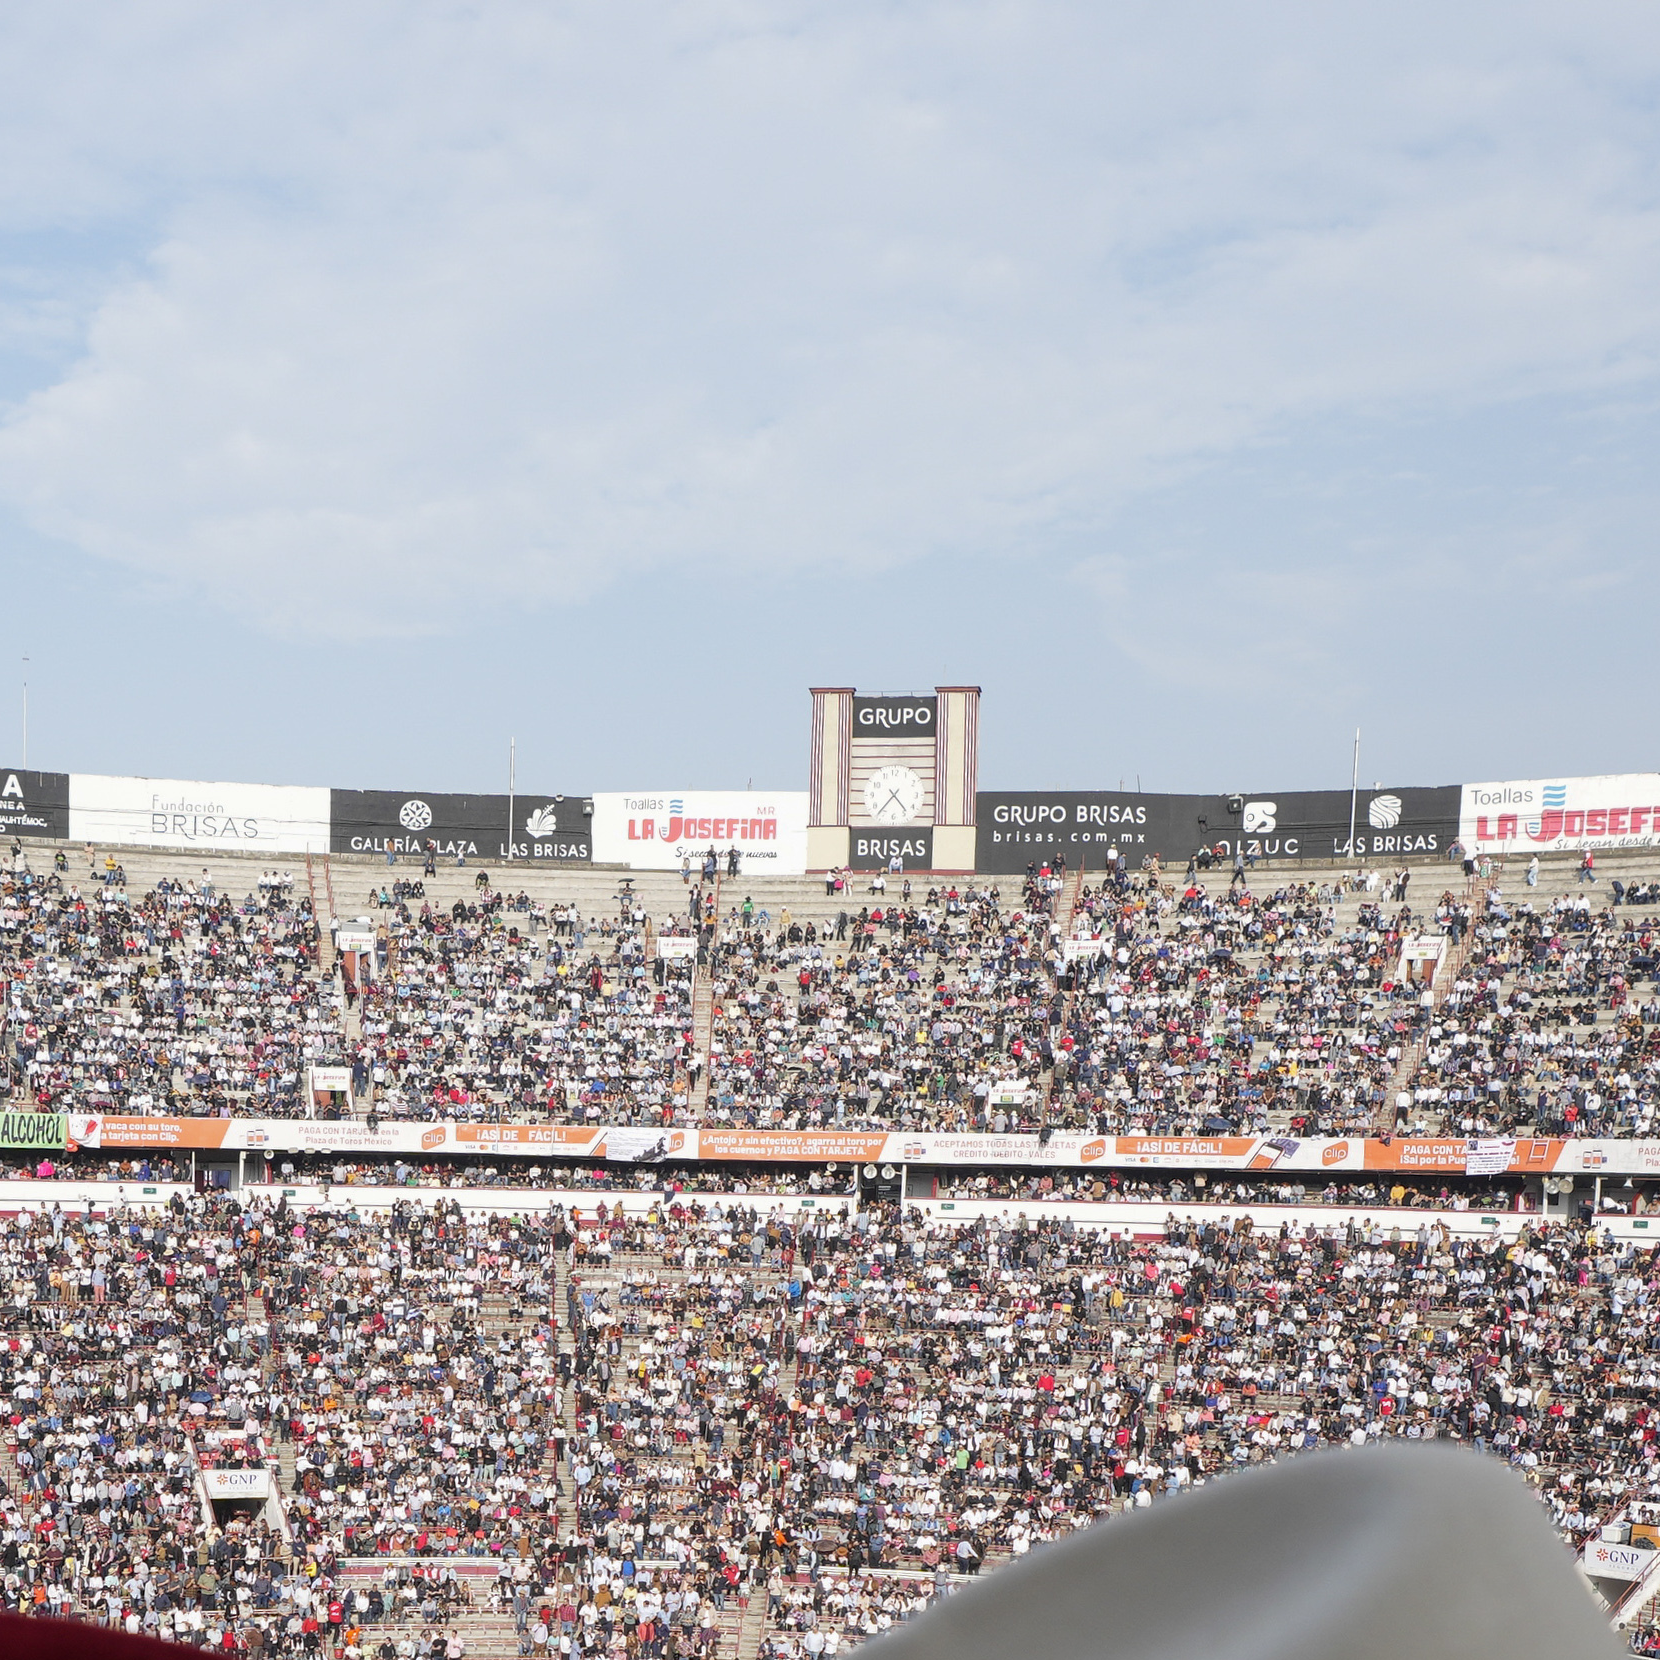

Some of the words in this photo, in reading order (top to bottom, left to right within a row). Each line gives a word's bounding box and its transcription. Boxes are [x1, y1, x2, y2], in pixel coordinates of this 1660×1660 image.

[859, 707, 931, 728] GRUPO
[152, 794, 224, 813] Fundación
[624, 798, 664, 810] Toallas
[1471, 788, 1533, 805] Toallas
[993, 805, 1067, 827] GRUPO
[1076, 805, 1147, 826] BRISAS
[152, 813, 258, 840] BRISAS
[628, 818, 654, 840] LA
[1477, 813, 1518, 841] LA
[500, 843, 528, 857] LAS
[536, 844, 588, 858] BRISAS
[857, 839, 926, 859] BRISAS
[1334, 837, 1366, 854] LAS
[1373, 834, 1438, 852] BRISAS
[1, 1114, 62, 1145] ALCOHOL
[148, 1124, 159, 1132] su
[503, 1130, 518, 1141] DE
[529, 1128, 566, 1142] FÁCIL!
[108, 1132, 140, 1142] tarjeta
[160, 1132, 179, 1143] Clip.
[1163, 1141, 1180, 1154] DE
[1183, 1139, 1222, 1154] FÁCIL!
[1324, 1147, 1347, 1161] clip
[1404, 1145, 1430, 1155] PAGA
[1432, 1145, 1452, 1155] CON
[229, 1474, 257, 1485] GNP
[1610, 1550, 1639, 1565] GNP
